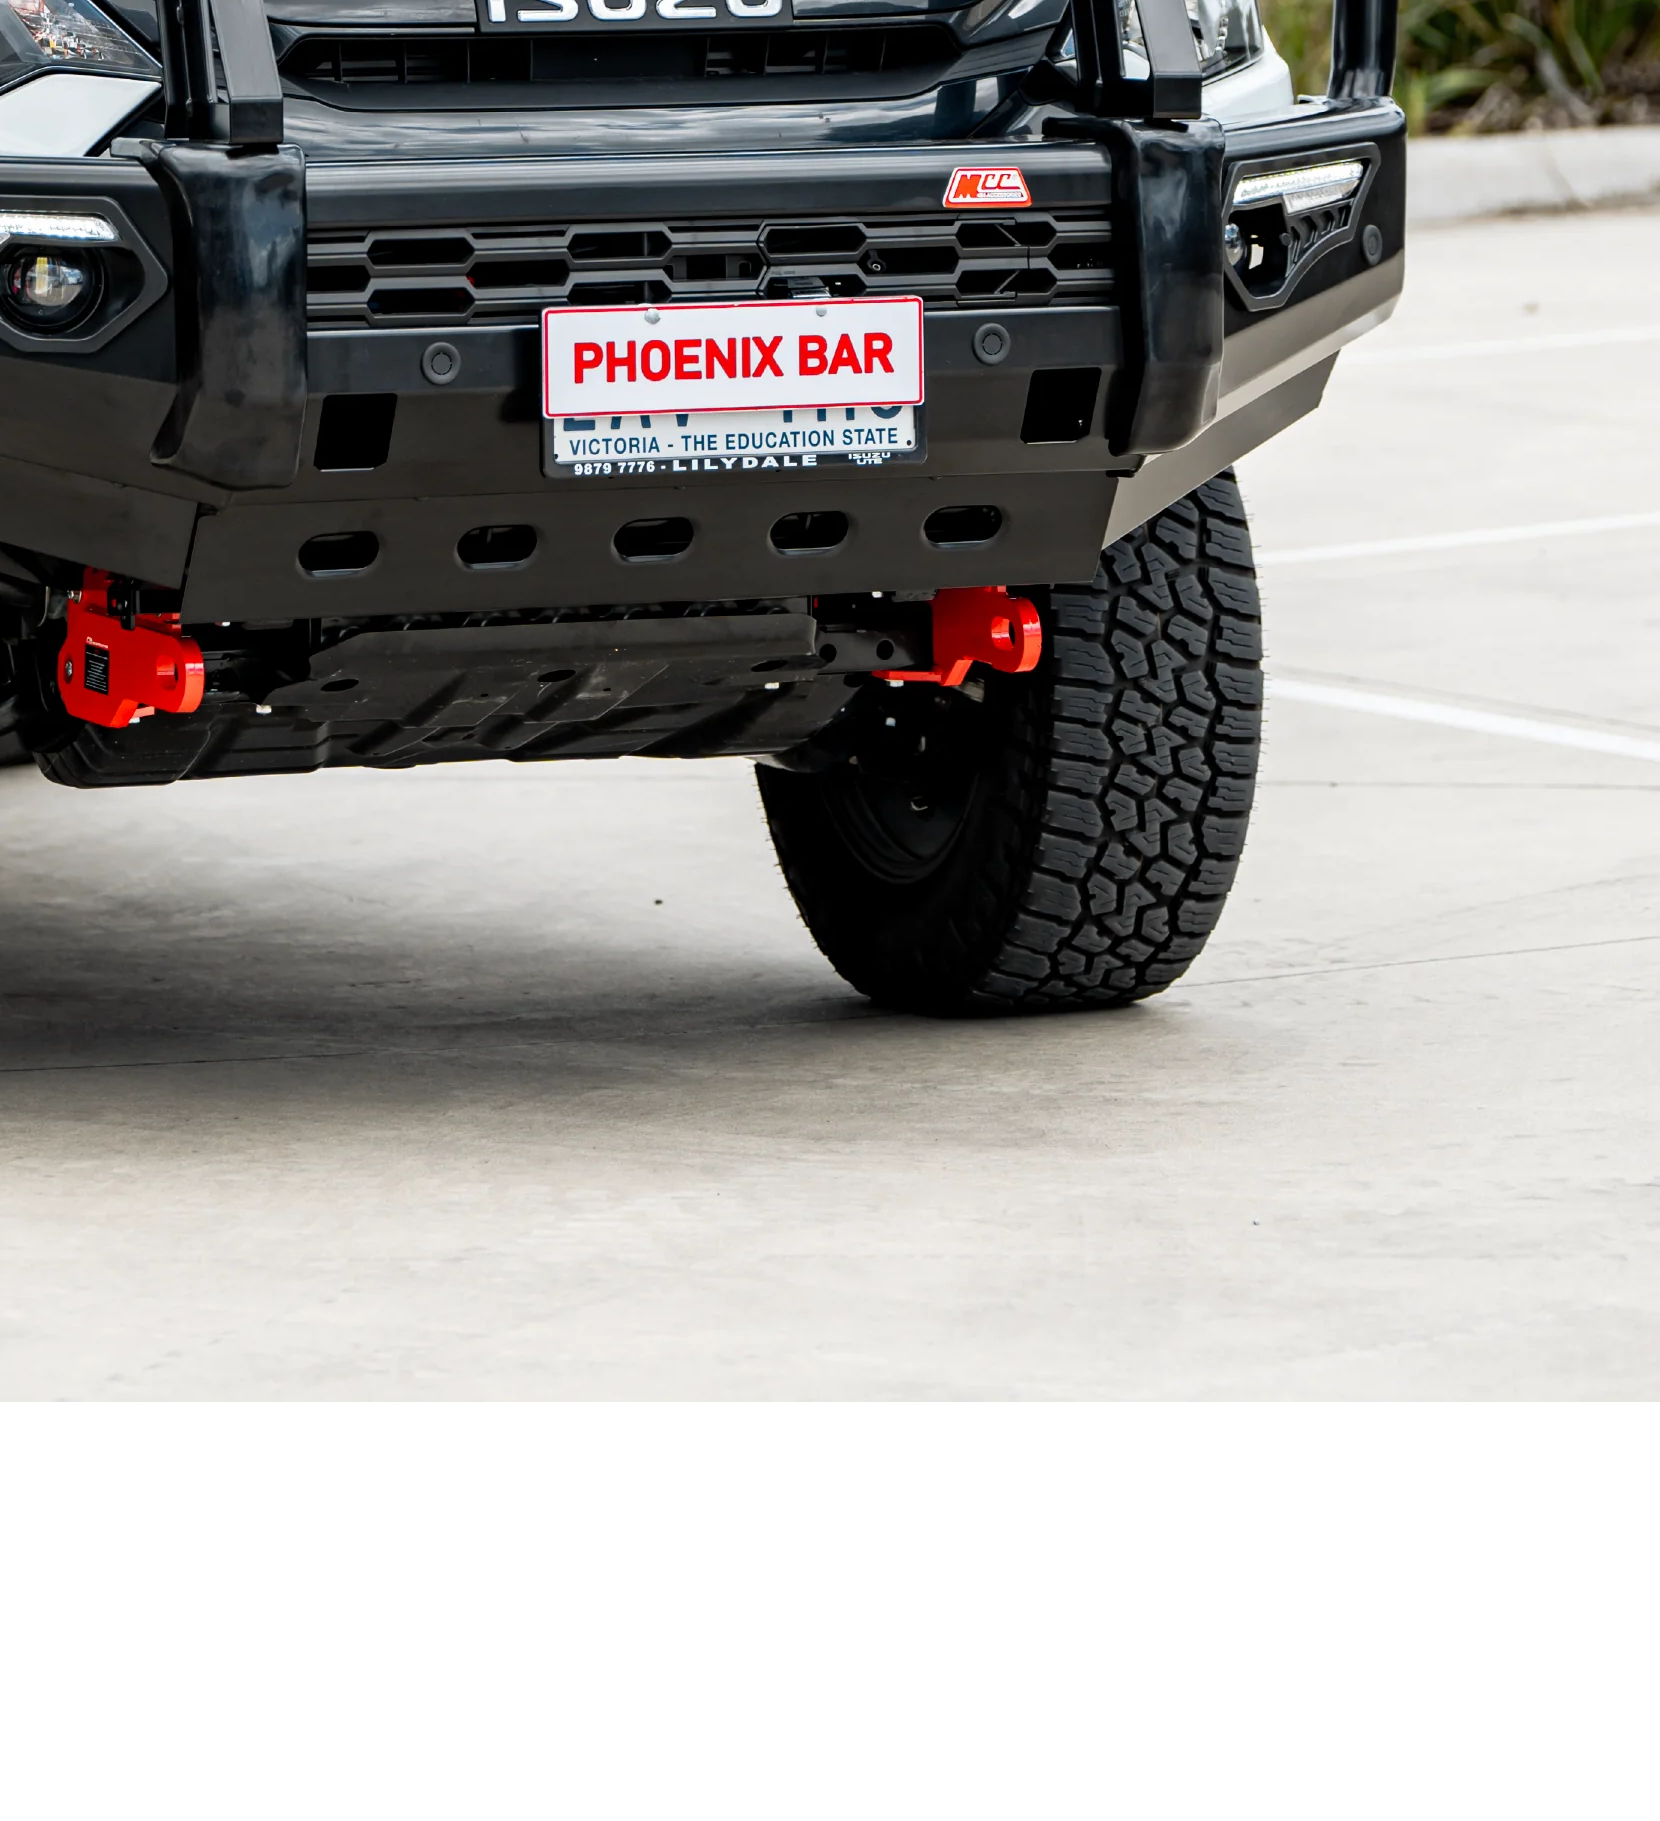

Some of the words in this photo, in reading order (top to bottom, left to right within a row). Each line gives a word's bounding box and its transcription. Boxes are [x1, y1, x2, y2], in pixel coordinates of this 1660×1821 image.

[574, 335, 783, 383] PHOENIX
[799, 332, 894, 376] BAR
[569, 437, 660, 455] VICTORIA
[681, 434, 718, 451] THE
[725, 429, 834, 450] EDUCATION
[842, 427, 898, 446] STATE
[574, 462, 612, 475] 9879
[617, 460, 655, 473] 7776
[672, 454, 818, 471] LILYDALE
[848, 452, 891, 460] ISUZU
